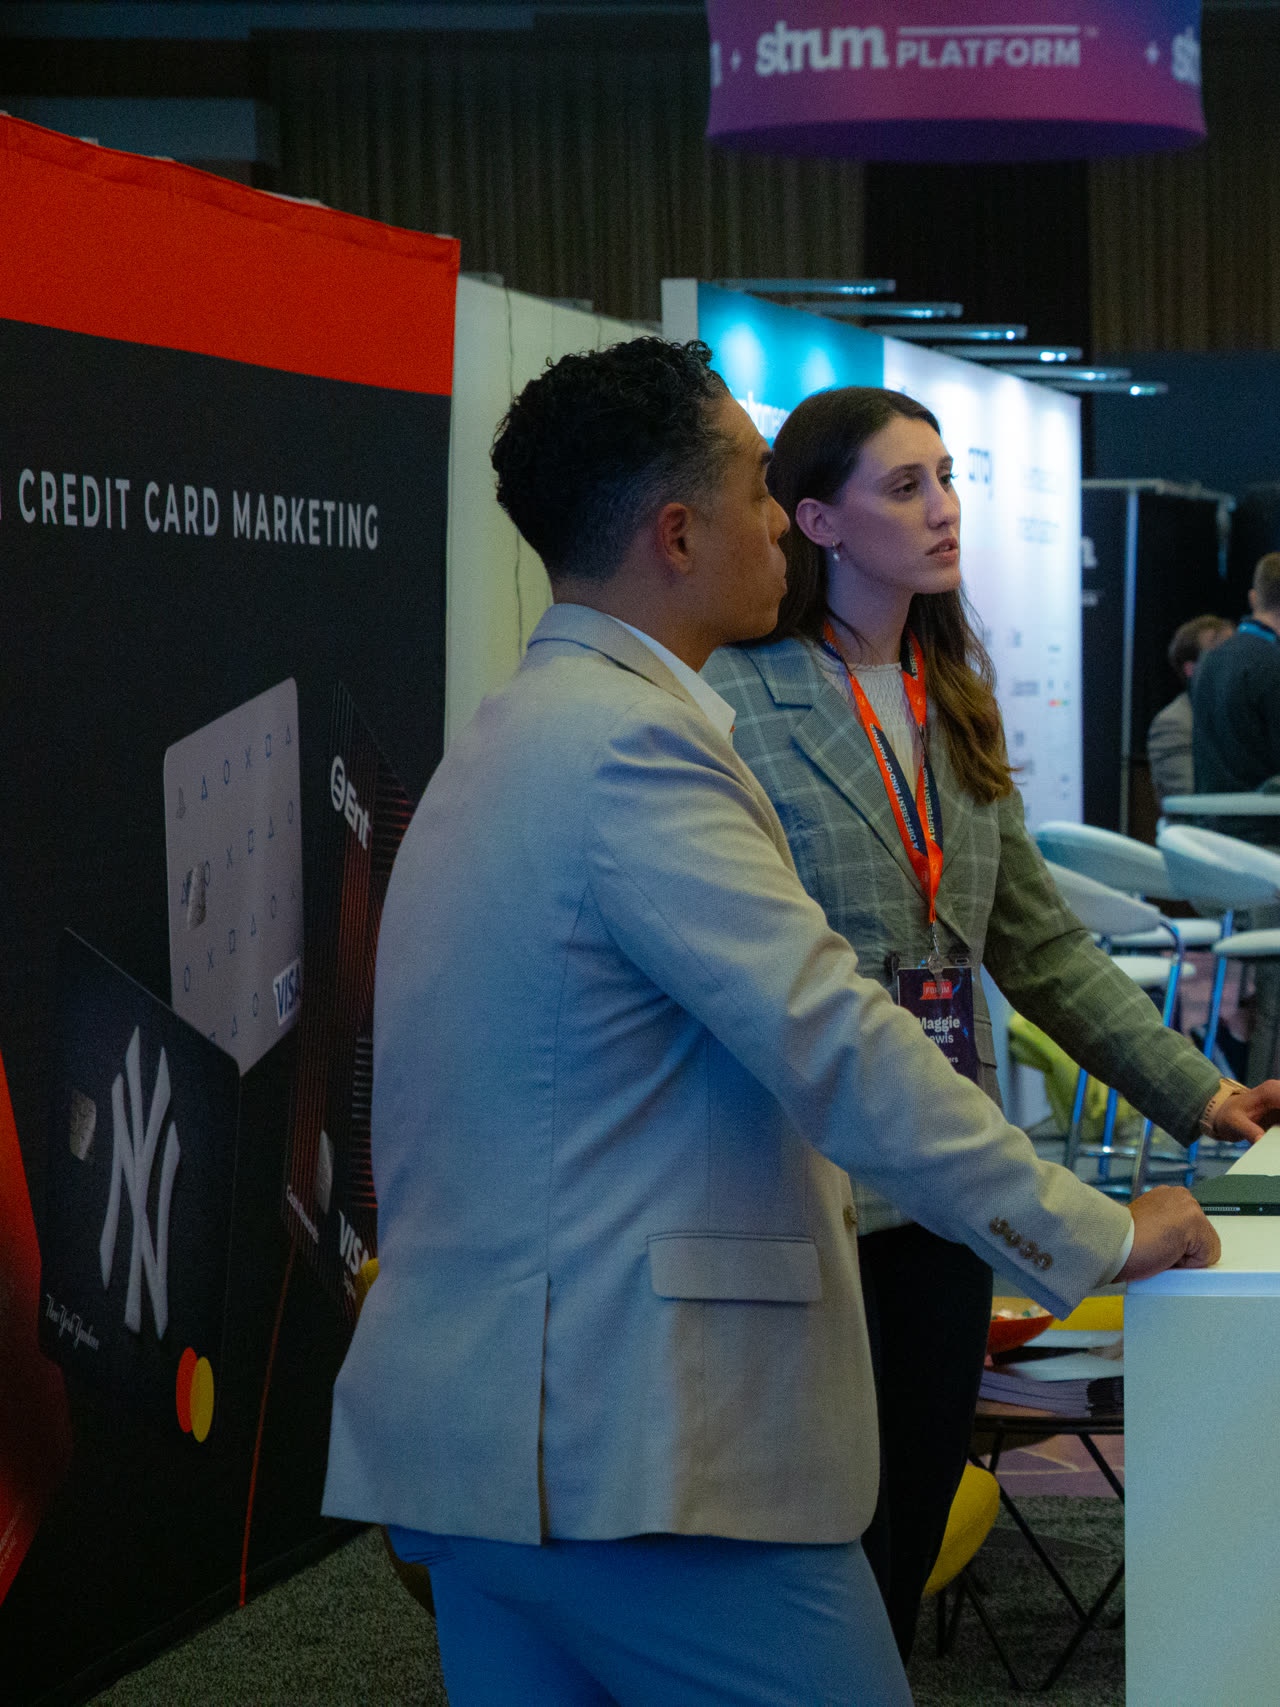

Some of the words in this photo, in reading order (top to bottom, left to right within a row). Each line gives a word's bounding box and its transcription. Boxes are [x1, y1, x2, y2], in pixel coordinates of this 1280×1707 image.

[755, 21, 888, 76] strum
[897, 37, 1081, 69] PLATFORM
[18, 467, 131, 530] CREDIT
[144, 480, 220, 538] CARD
[232, 488, 380, 552] MARKETING
[885, 761, 893, 772] OF
[889, 773, 902, 795] KIND
[344, 780, 372, 850] Ent
[896, 796, 917, 841] DIFFERENT
[924, 788, 935, 834] DIFFERENT
[913, 841, 920, 849] A
